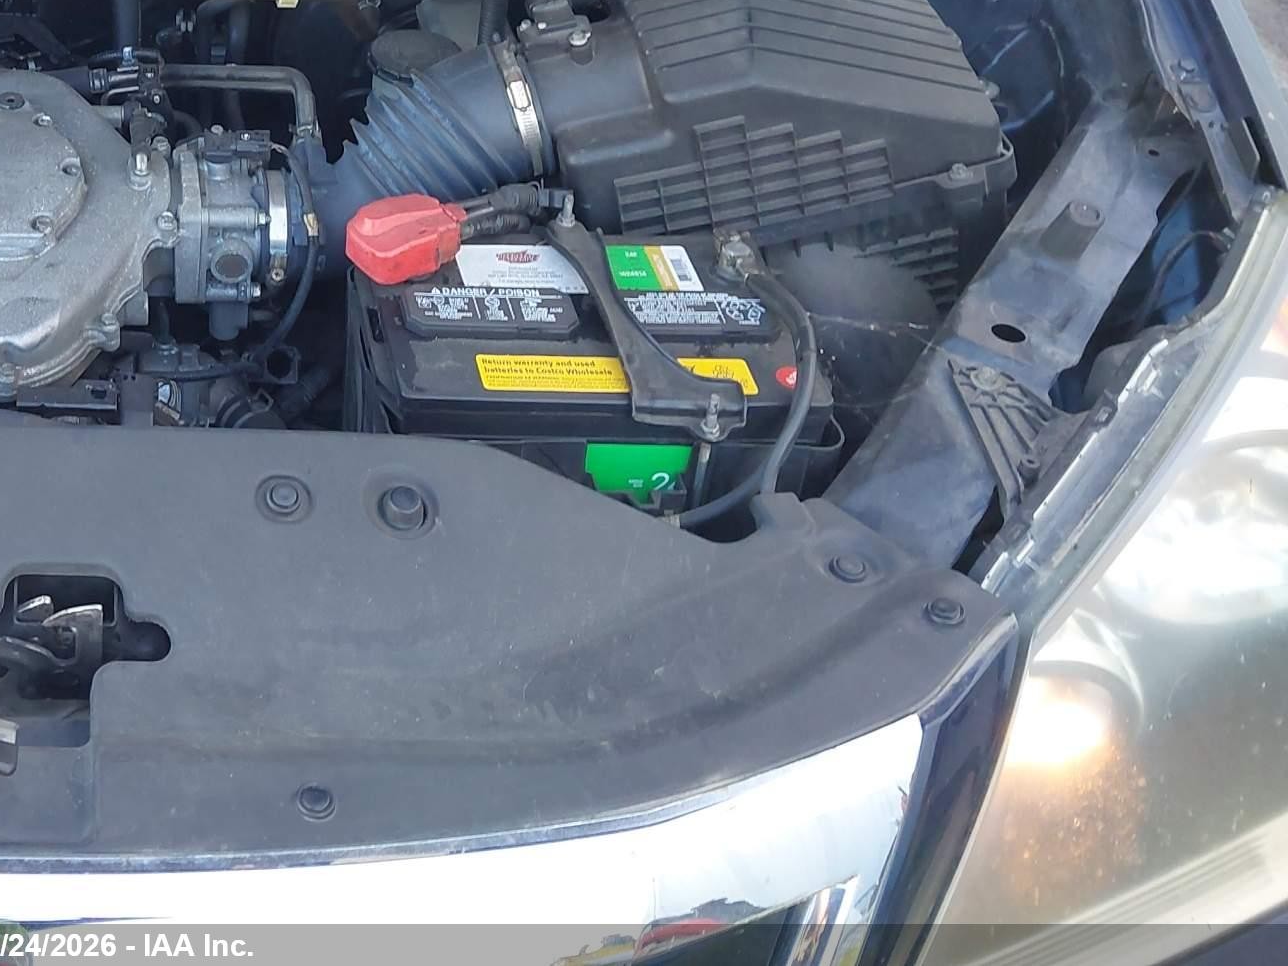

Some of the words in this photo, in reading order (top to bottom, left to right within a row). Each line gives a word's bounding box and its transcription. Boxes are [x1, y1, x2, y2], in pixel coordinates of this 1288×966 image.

[442, 287, 487, 296] DANGER
[498, 289, 540, 297] POISON
[481, 358, 513, 366] Return
[514, 359, 553, 368] warranty
[484, 366, 523, 374] batteries
[536, 367, 564, 375] Costco
[566, 368, 613, 376] Wholesale
